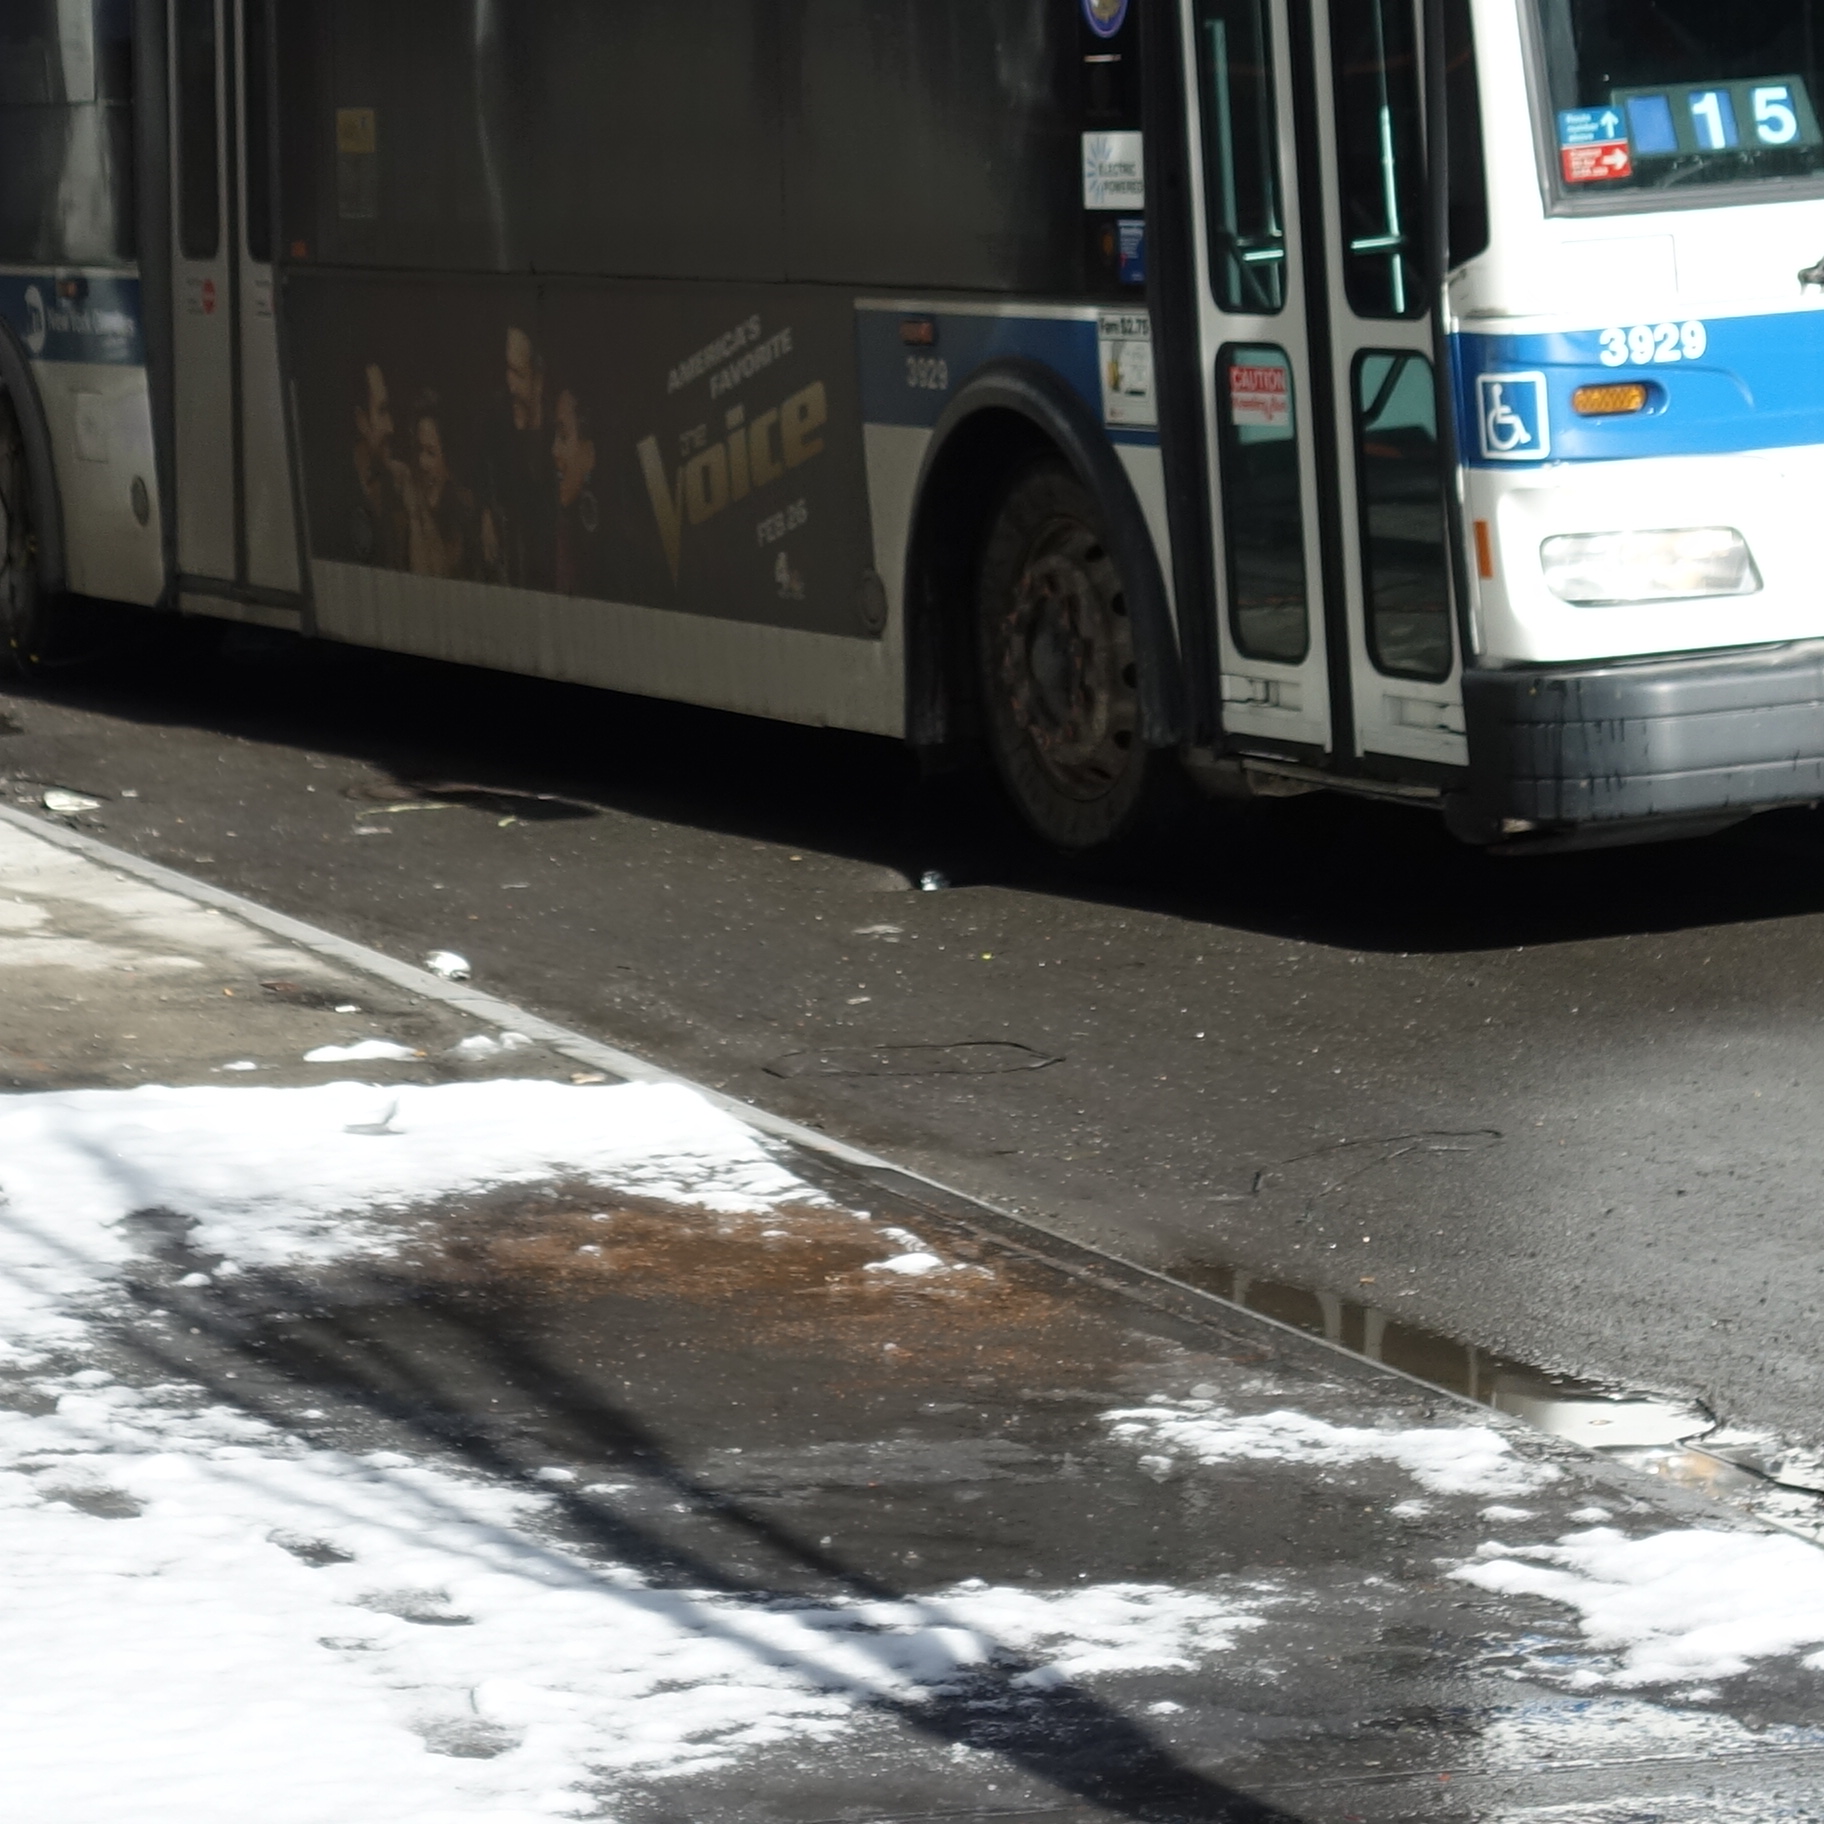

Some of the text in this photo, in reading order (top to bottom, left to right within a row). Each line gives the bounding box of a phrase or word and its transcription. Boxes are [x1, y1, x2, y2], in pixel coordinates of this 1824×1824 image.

[667, 313, 762, 395] AMERICA'S
[709, 327, 793, 400] FAVORITE
[1599, 319, 1708, 367] 3929
[905, 356, 949, 390] 3929
[1230, 367, 1285, 391] CAUTION
[635, 379, 828, 581] Voice
[756, 497, 808, 548] FEB 26
